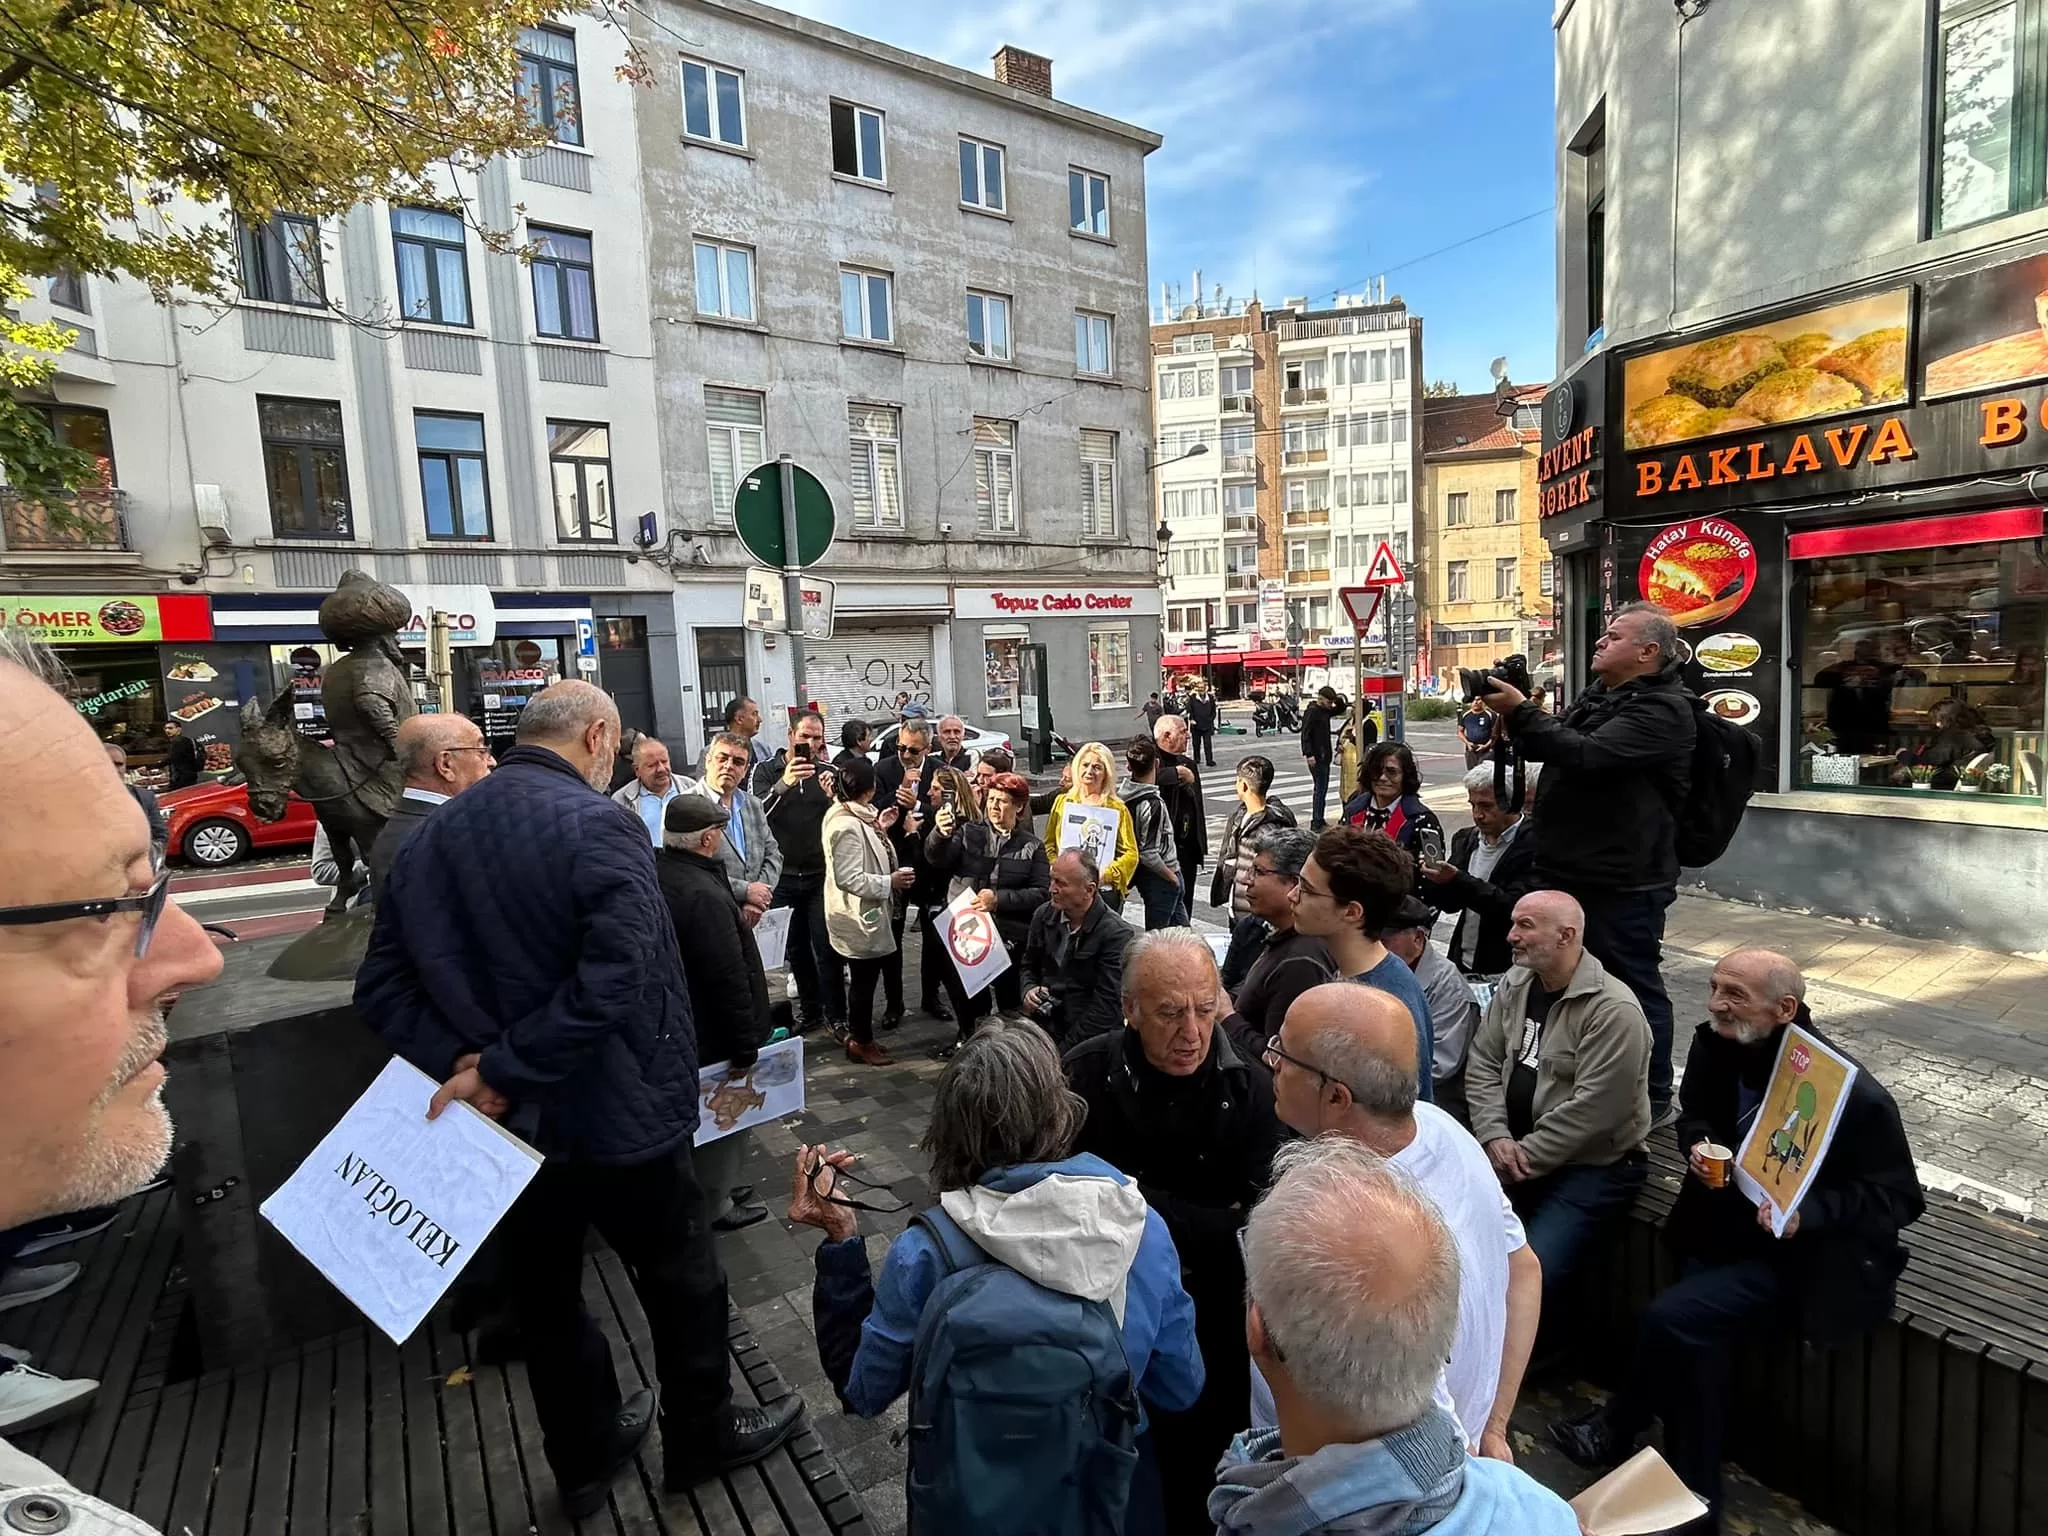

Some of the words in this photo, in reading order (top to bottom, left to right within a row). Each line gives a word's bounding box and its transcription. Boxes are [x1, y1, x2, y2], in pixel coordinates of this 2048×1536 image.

[1537, 426, 1594, 483] LEVENT
[1636, 417, 1914, 497] BAKLAVA
[1647, 525, 1688, 560] Hatay
[1700, 521, 1750, 559] Künefe
[15, 607, 92, 627] ÖMER
[992, 592, 1038, 613] Topuz
[1042, 593, 1082, 610] Cado
[1085, 593, 1132, 609] Center
[51, 629, 64, 637] 85
[580, 623, 592, 649] P
[75, 679, 149, 715] egetarian
[1790, 1049, 1810, 1070] STOP
[334, 1151, 461, 1268] KELOĞLAN
